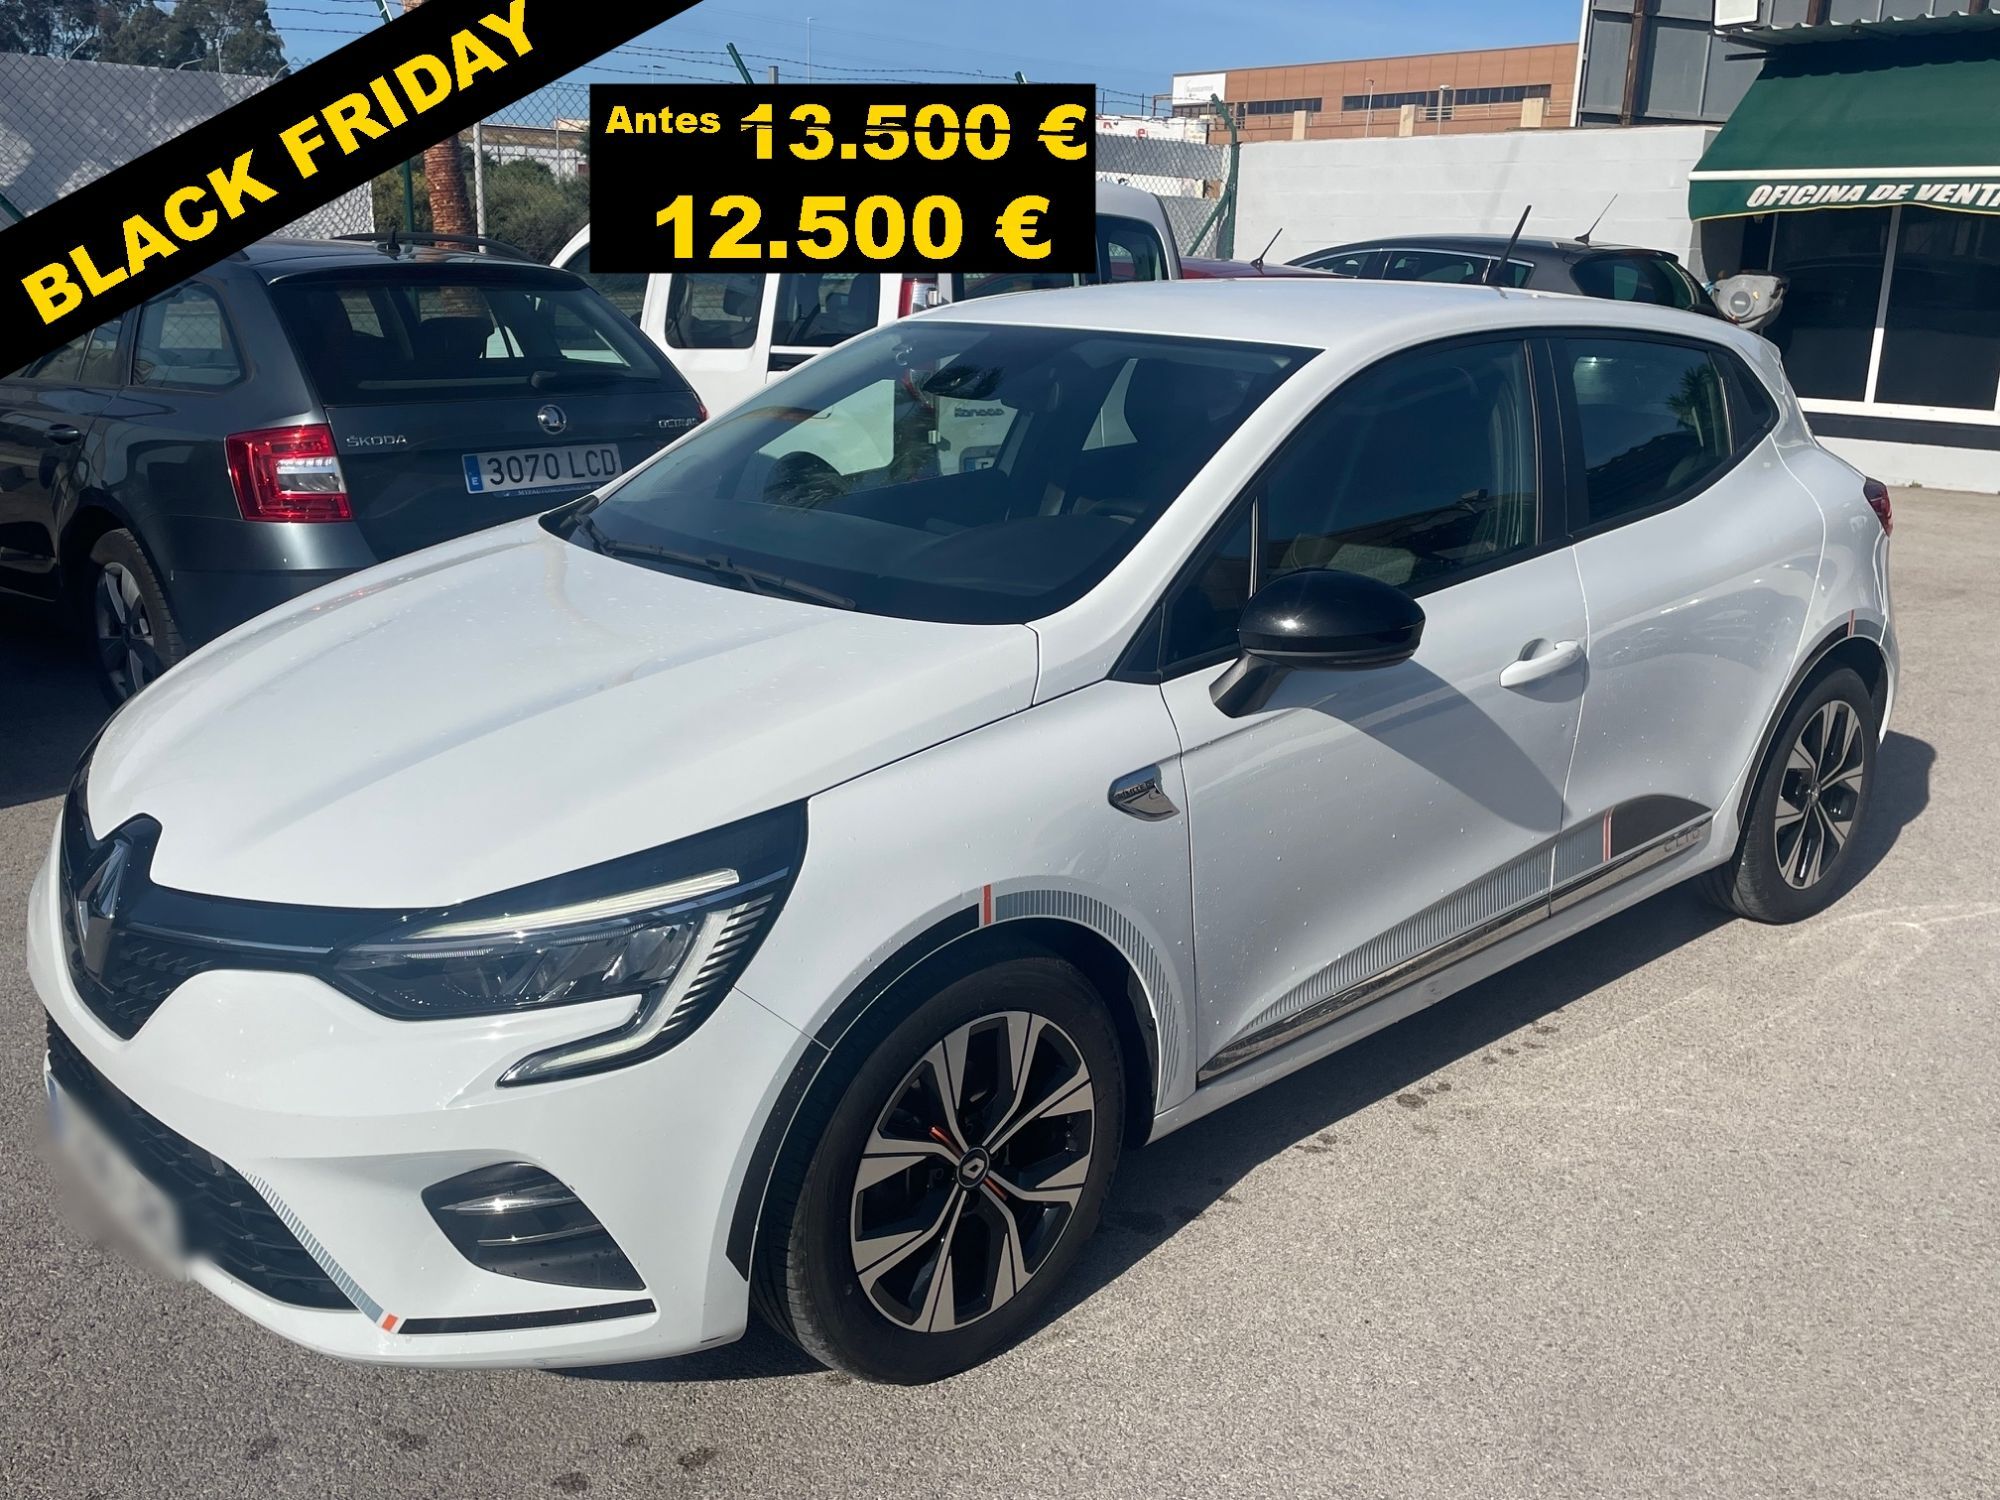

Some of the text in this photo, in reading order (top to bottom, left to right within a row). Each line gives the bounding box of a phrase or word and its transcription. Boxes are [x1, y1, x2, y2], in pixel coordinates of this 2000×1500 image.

[1747, 184, 1867, 207] OFICINA
[1867, 184, 1915, 201] DE
[487, 449, 616, 485] 3070 LCD
